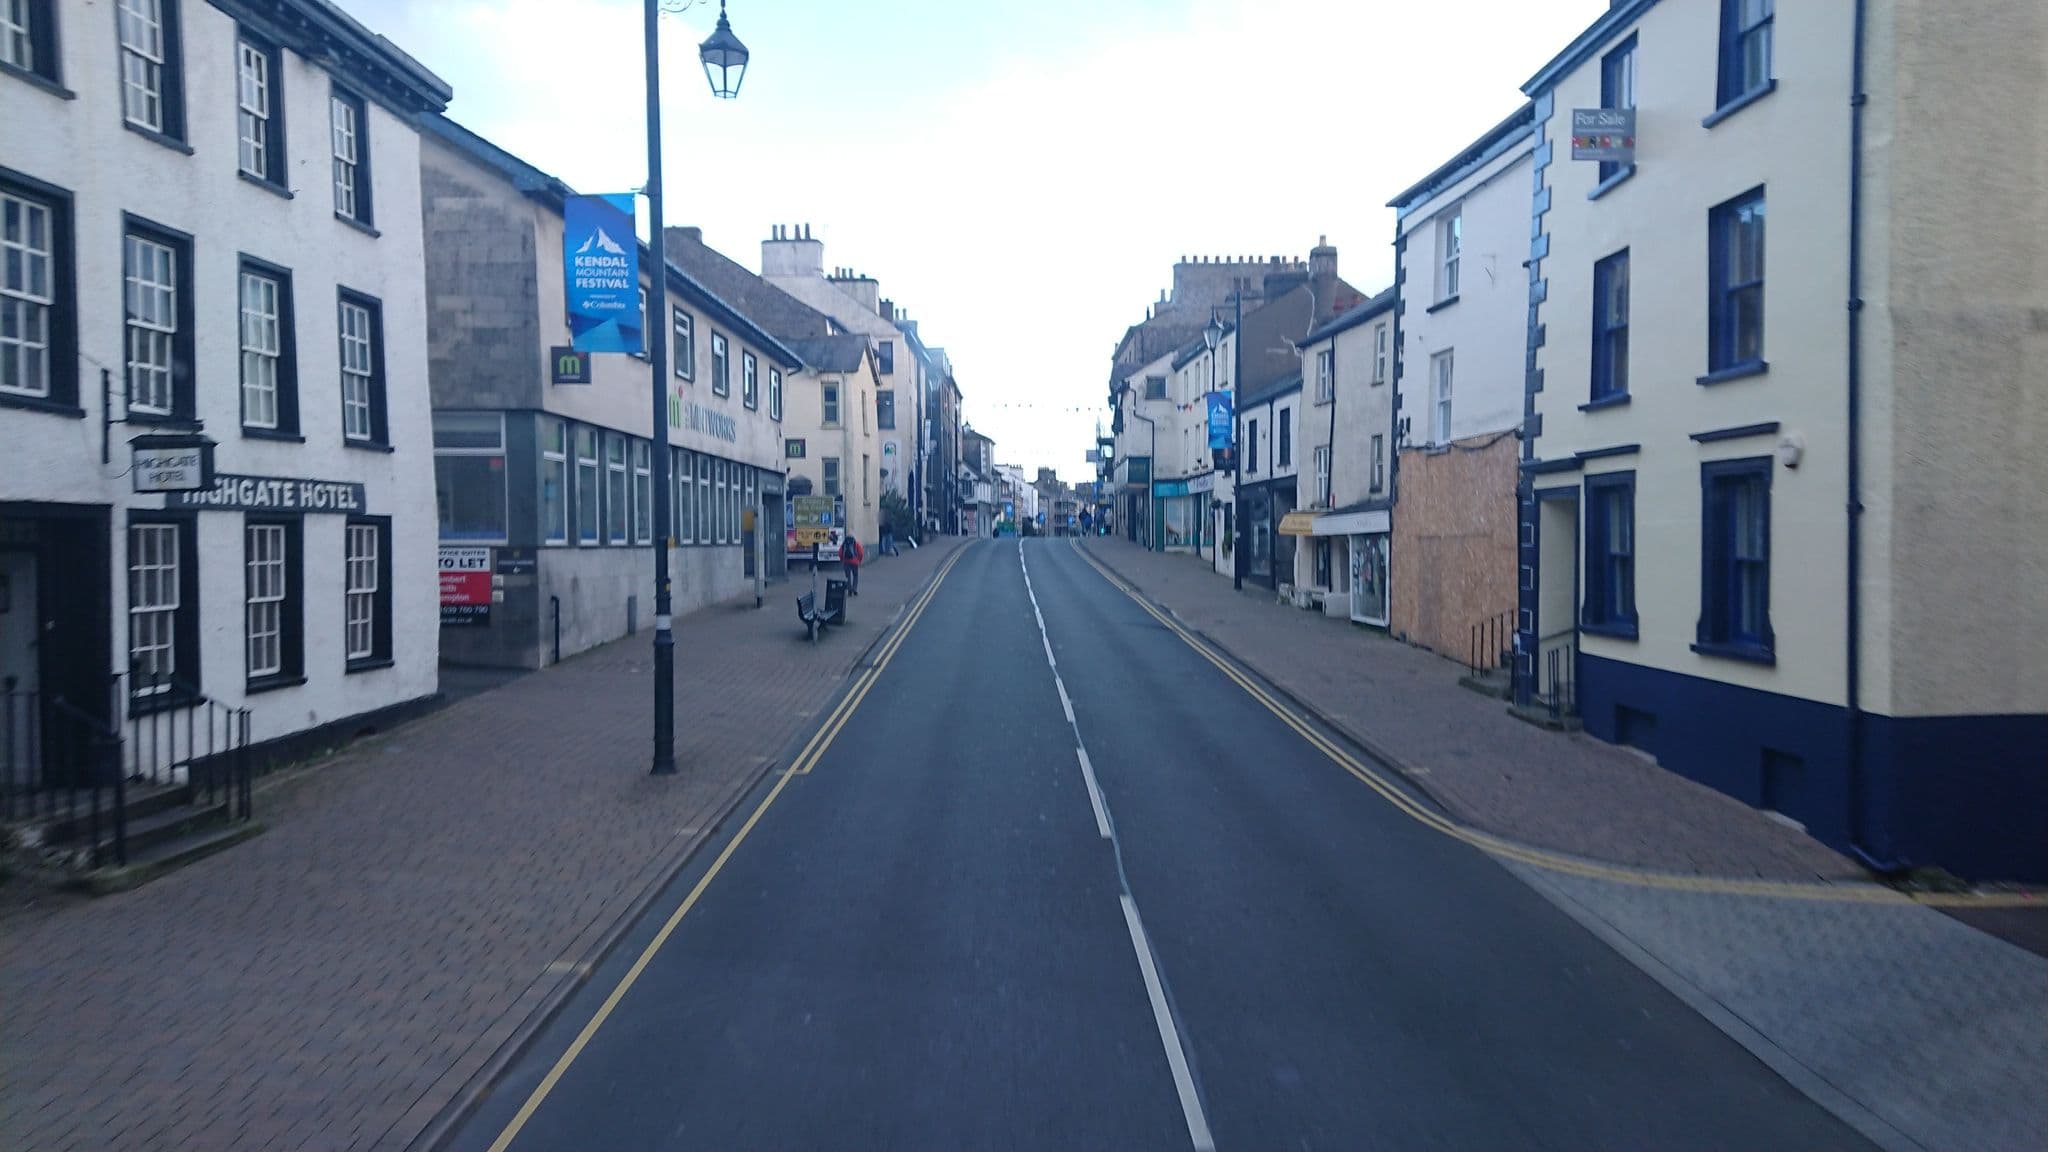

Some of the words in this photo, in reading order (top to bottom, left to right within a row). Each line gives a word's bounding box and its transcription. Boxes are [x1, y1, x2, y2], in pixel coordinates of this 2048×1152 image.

[1575, 112, 1595, 125] For
[1599, 112, 1625, 125] Sale
[575, 256, 628, 267] KENDAL
[576, 268, 628, 277] MOUNTAIN
[576, 278, 629, 288] FESTIVAL
[135, 454, 198, 470] HIGHGATE
[150, 471, 184, 483] HOTEL
[300, 483, 358, 509] HOTEL
[459, 558, 486, 569] LET
